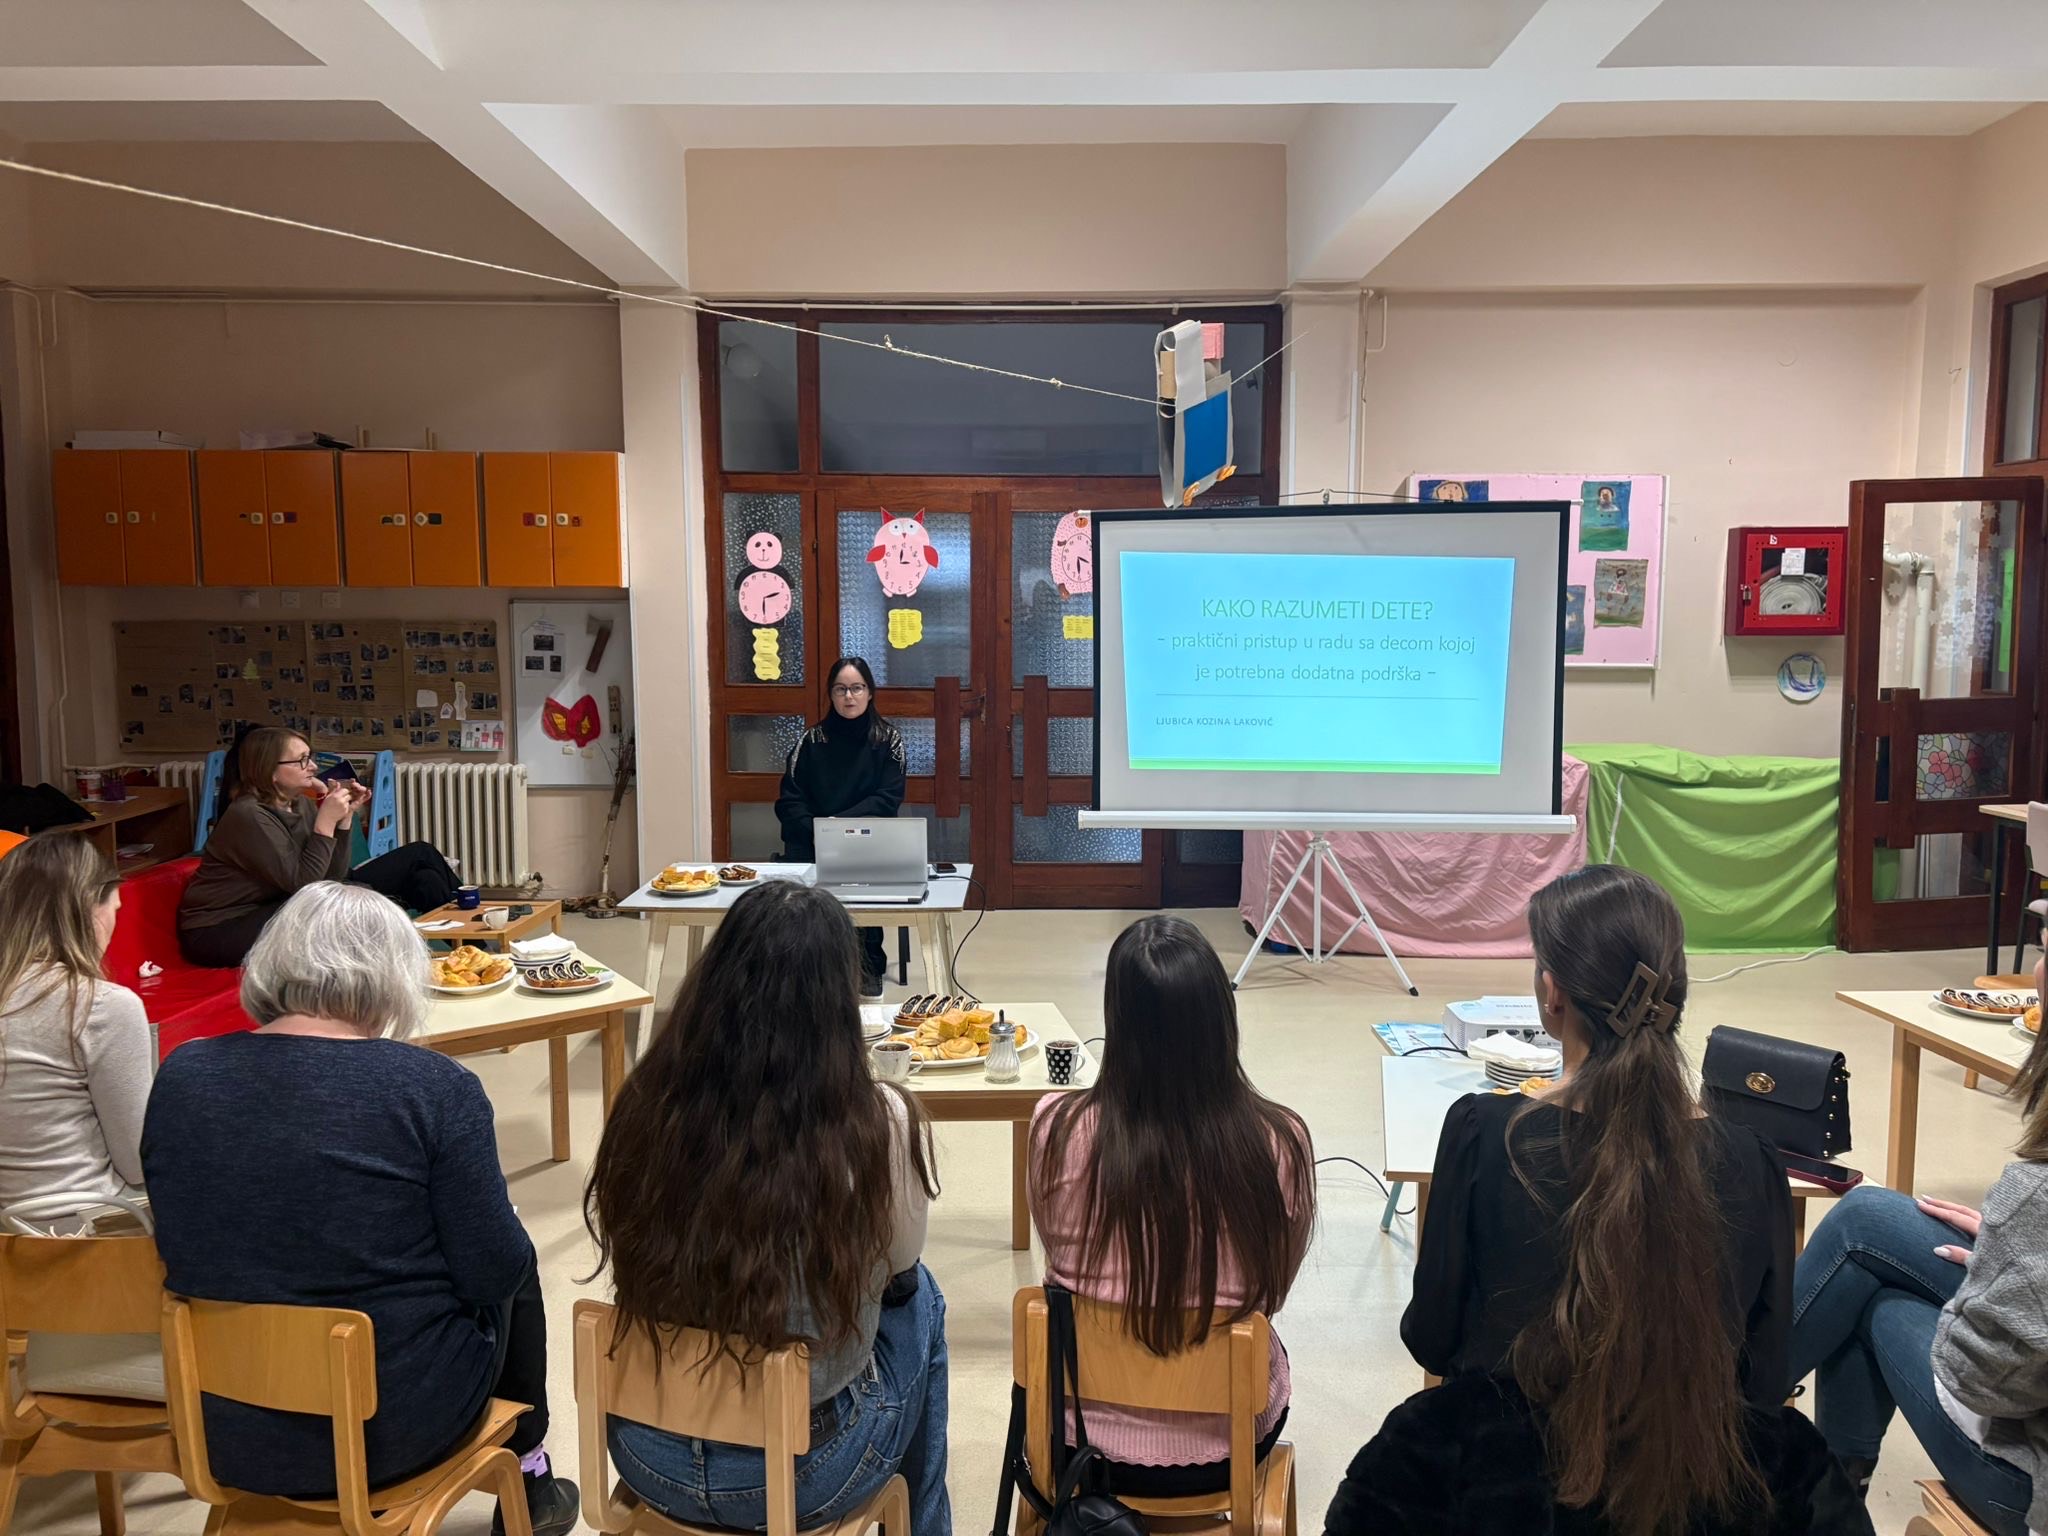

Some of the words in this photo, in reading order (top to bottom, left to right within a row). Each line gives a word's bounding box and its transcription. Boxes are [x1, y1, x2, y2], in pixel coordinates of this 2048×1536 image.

[1202, 599, 1255, 618] KAKO
[1261, 599, 1365, 619] RAZUMETI
[1371, 601, 1434, 620] DETE?
[1172, 632, 1238, 650] praktični
[1244, 633, 1297, 651] pristup
[1304, 638, 1313, 649] u
[1319, 633, 1353, 649] radu
[1359, 639, 1375, 650] sa
[1380, 635, 1433, 650] decom
[1439, 635, 1475, 654] kojoj
[1195, 664, 1210, 681] je
[1215, 664, 1285, 681] potrebna
[1291, 664, 1354, 680] dodatna
[1361, 664, 1421, 683] podrška
[1156, 717, 1194, 726] LJUBICA
[1197, 717, 1231, 726] KOZINA
